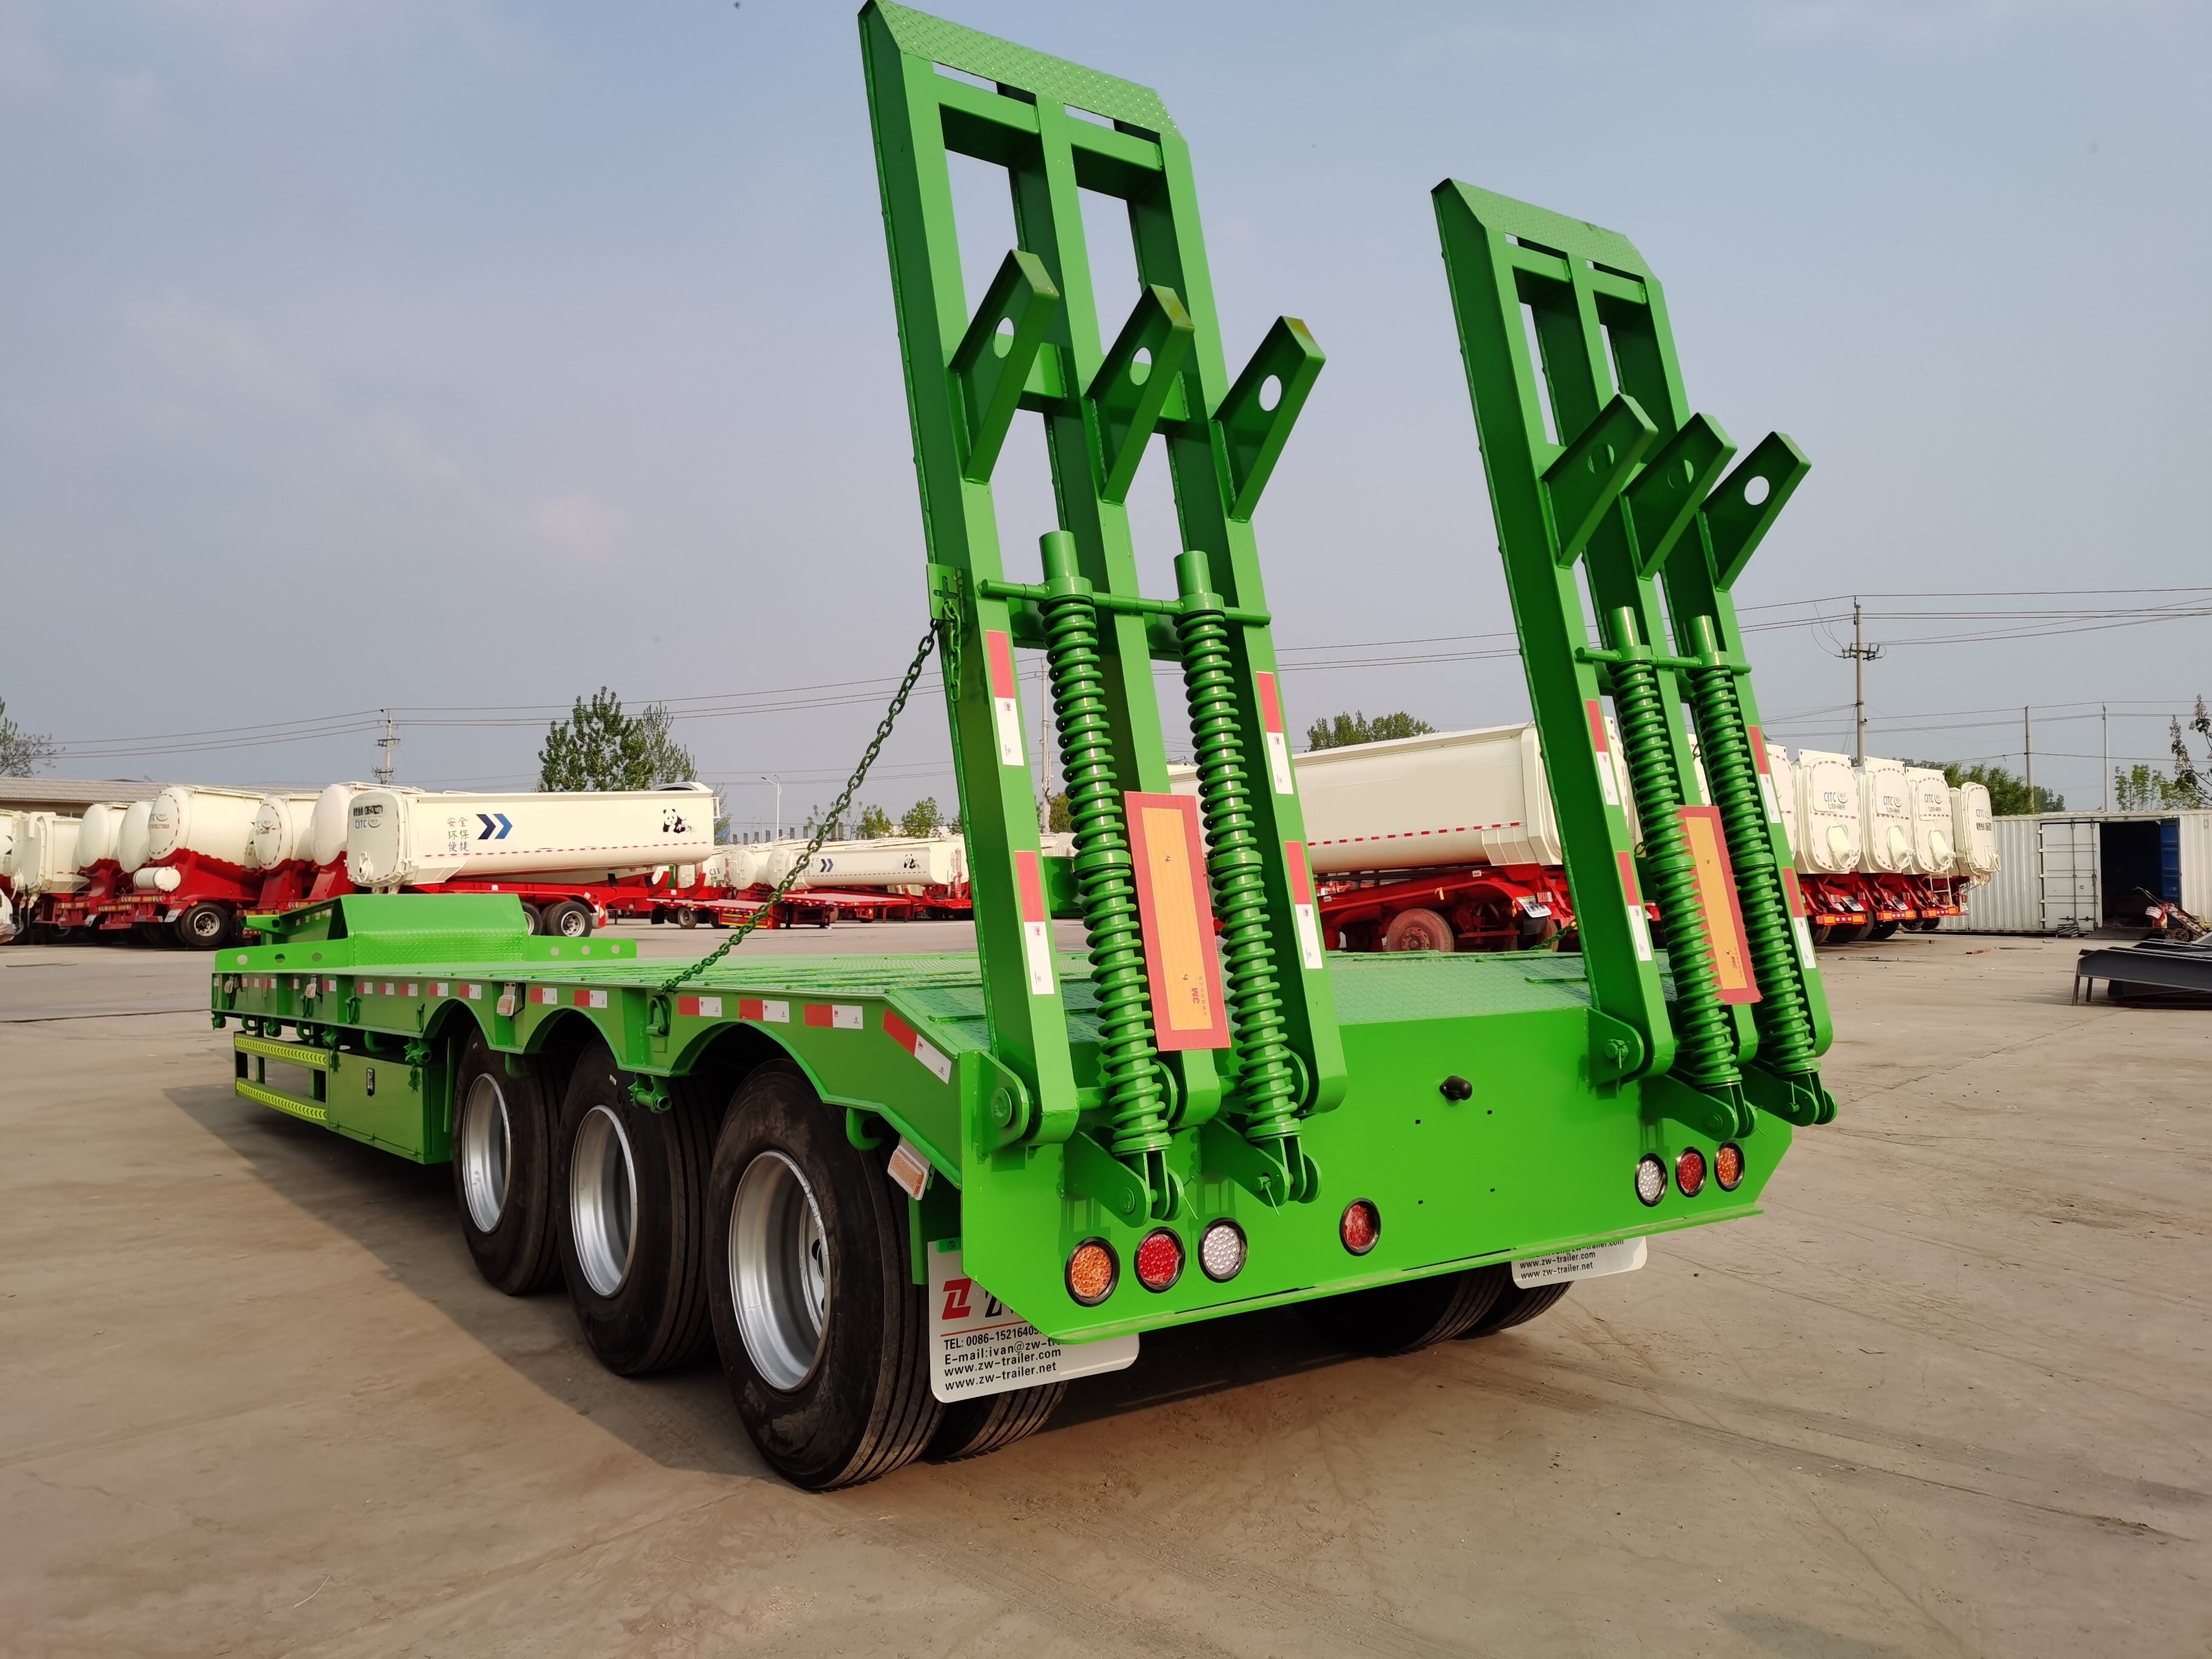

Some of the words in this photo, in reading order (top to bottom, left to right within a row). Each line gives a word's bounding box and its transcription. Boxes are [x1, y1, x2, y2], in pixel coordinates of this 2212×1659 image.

[447, 817, 468, 827] 安全
[447, 830, 469, 840] 环保
[1191, 987, 1200, 1004] 3M
[1520, 1252, 1596, 1269] www.zw-trailer.com
[1521, 1262, 1594, 1279] www.zw-trailer.net
[967, 1326, 1043, 1346] 0086-15216409
[944, 1349, 1061, 1377] www.zw-trailer.com
[945, 1361, 1056, 1390] www.zw-trailer.net
